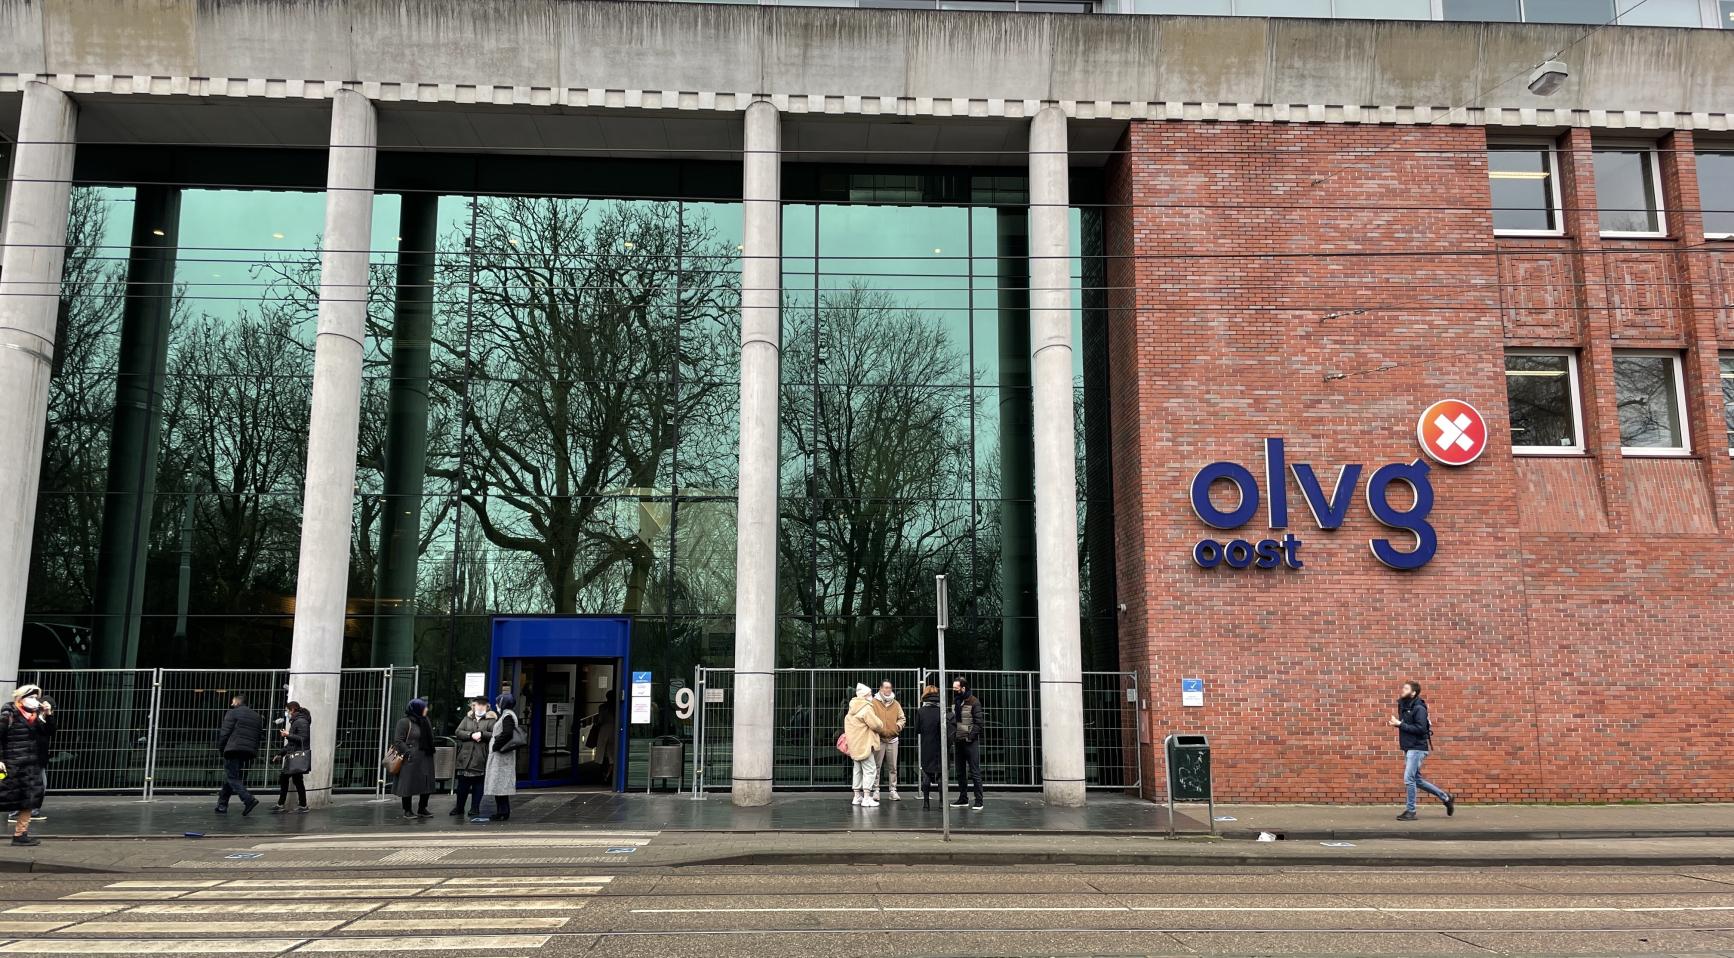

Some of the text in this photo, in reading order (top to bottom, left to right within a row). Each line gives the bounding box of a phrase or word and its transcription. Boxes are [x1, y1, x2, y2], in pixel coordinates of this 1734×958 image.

[1190, 437, 1437, 570] olvg
[1193, 533, 1304, 569] oost
[675, 687, 695, 720] 9
